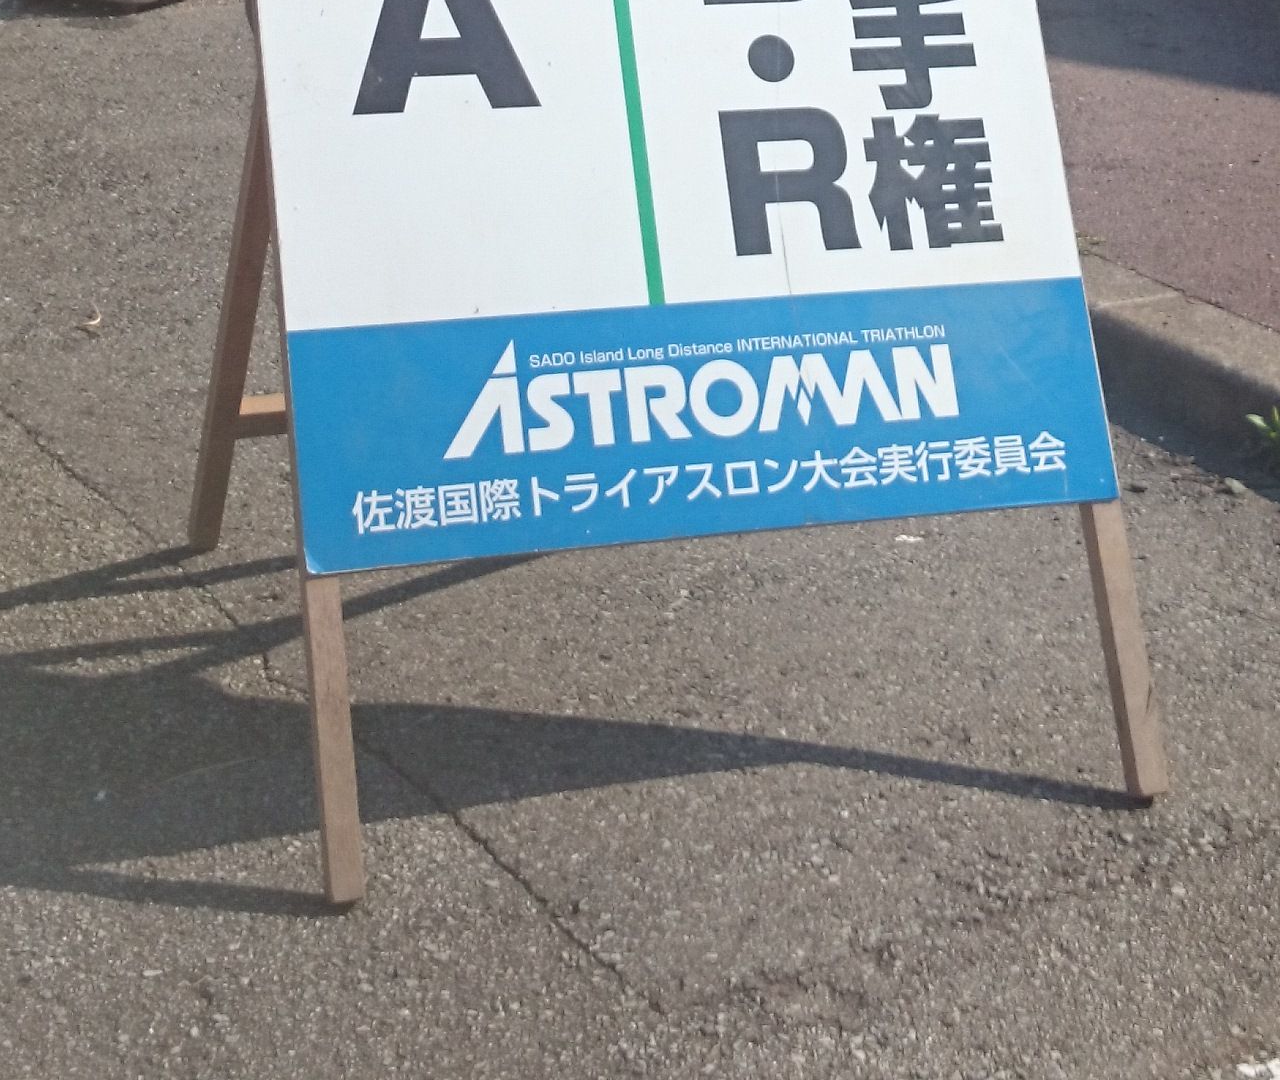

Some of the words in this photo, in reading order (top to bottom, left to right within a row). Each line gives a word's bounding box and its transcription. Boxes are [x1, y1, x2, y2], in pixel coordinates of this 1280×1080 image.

[529, 352, 575, 368] SADO
[580, 347, 623, 364] Island
[628, 344, 664, 361] Long
[668, 341, 733, 358] Distance
[737, 330, 857, 352] INTERNATIONAL
[861, 324, 946, 342] TRIATHLON
[443, 339, 959, 460] ASTROMAN
[352, 430, 1067, 535] 佐渡国際トライアスロン大会実行委員会
